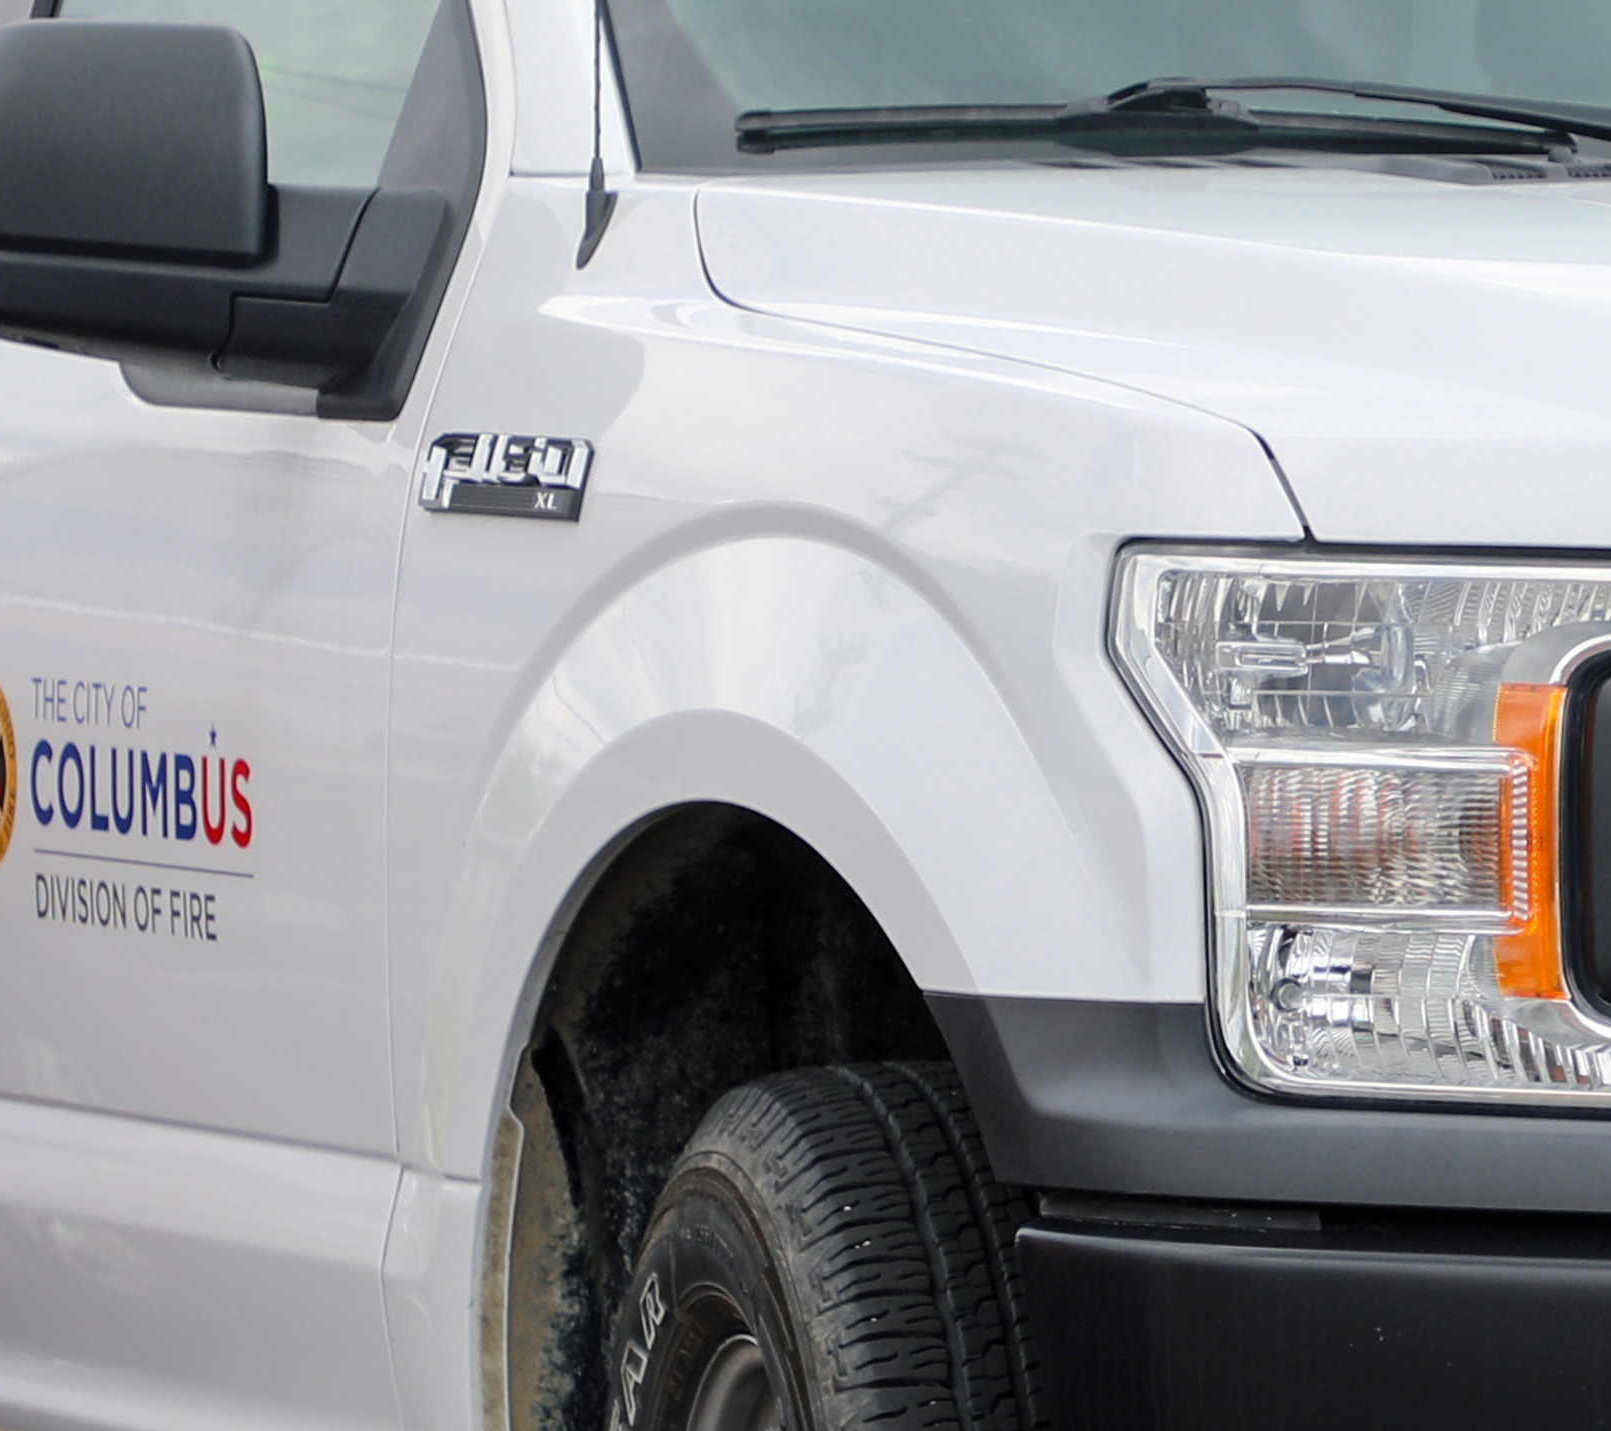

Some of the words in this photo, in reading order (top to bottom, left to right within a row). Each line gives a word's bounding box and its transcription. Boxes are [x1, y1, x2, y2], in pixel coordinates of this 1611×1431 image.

[534, 491, 558, 511] XL
[31, 677, 67, 723] THE
[73, 680, 116, 727] CITY
[121, 684, 148, 730] OF
[30, 738, 253, 849] COLUMBUS
[34, 872, 127, 930] DIVISION
[133, 884, 163, 935] OF
[169, 888, 219, 942] FIRE
